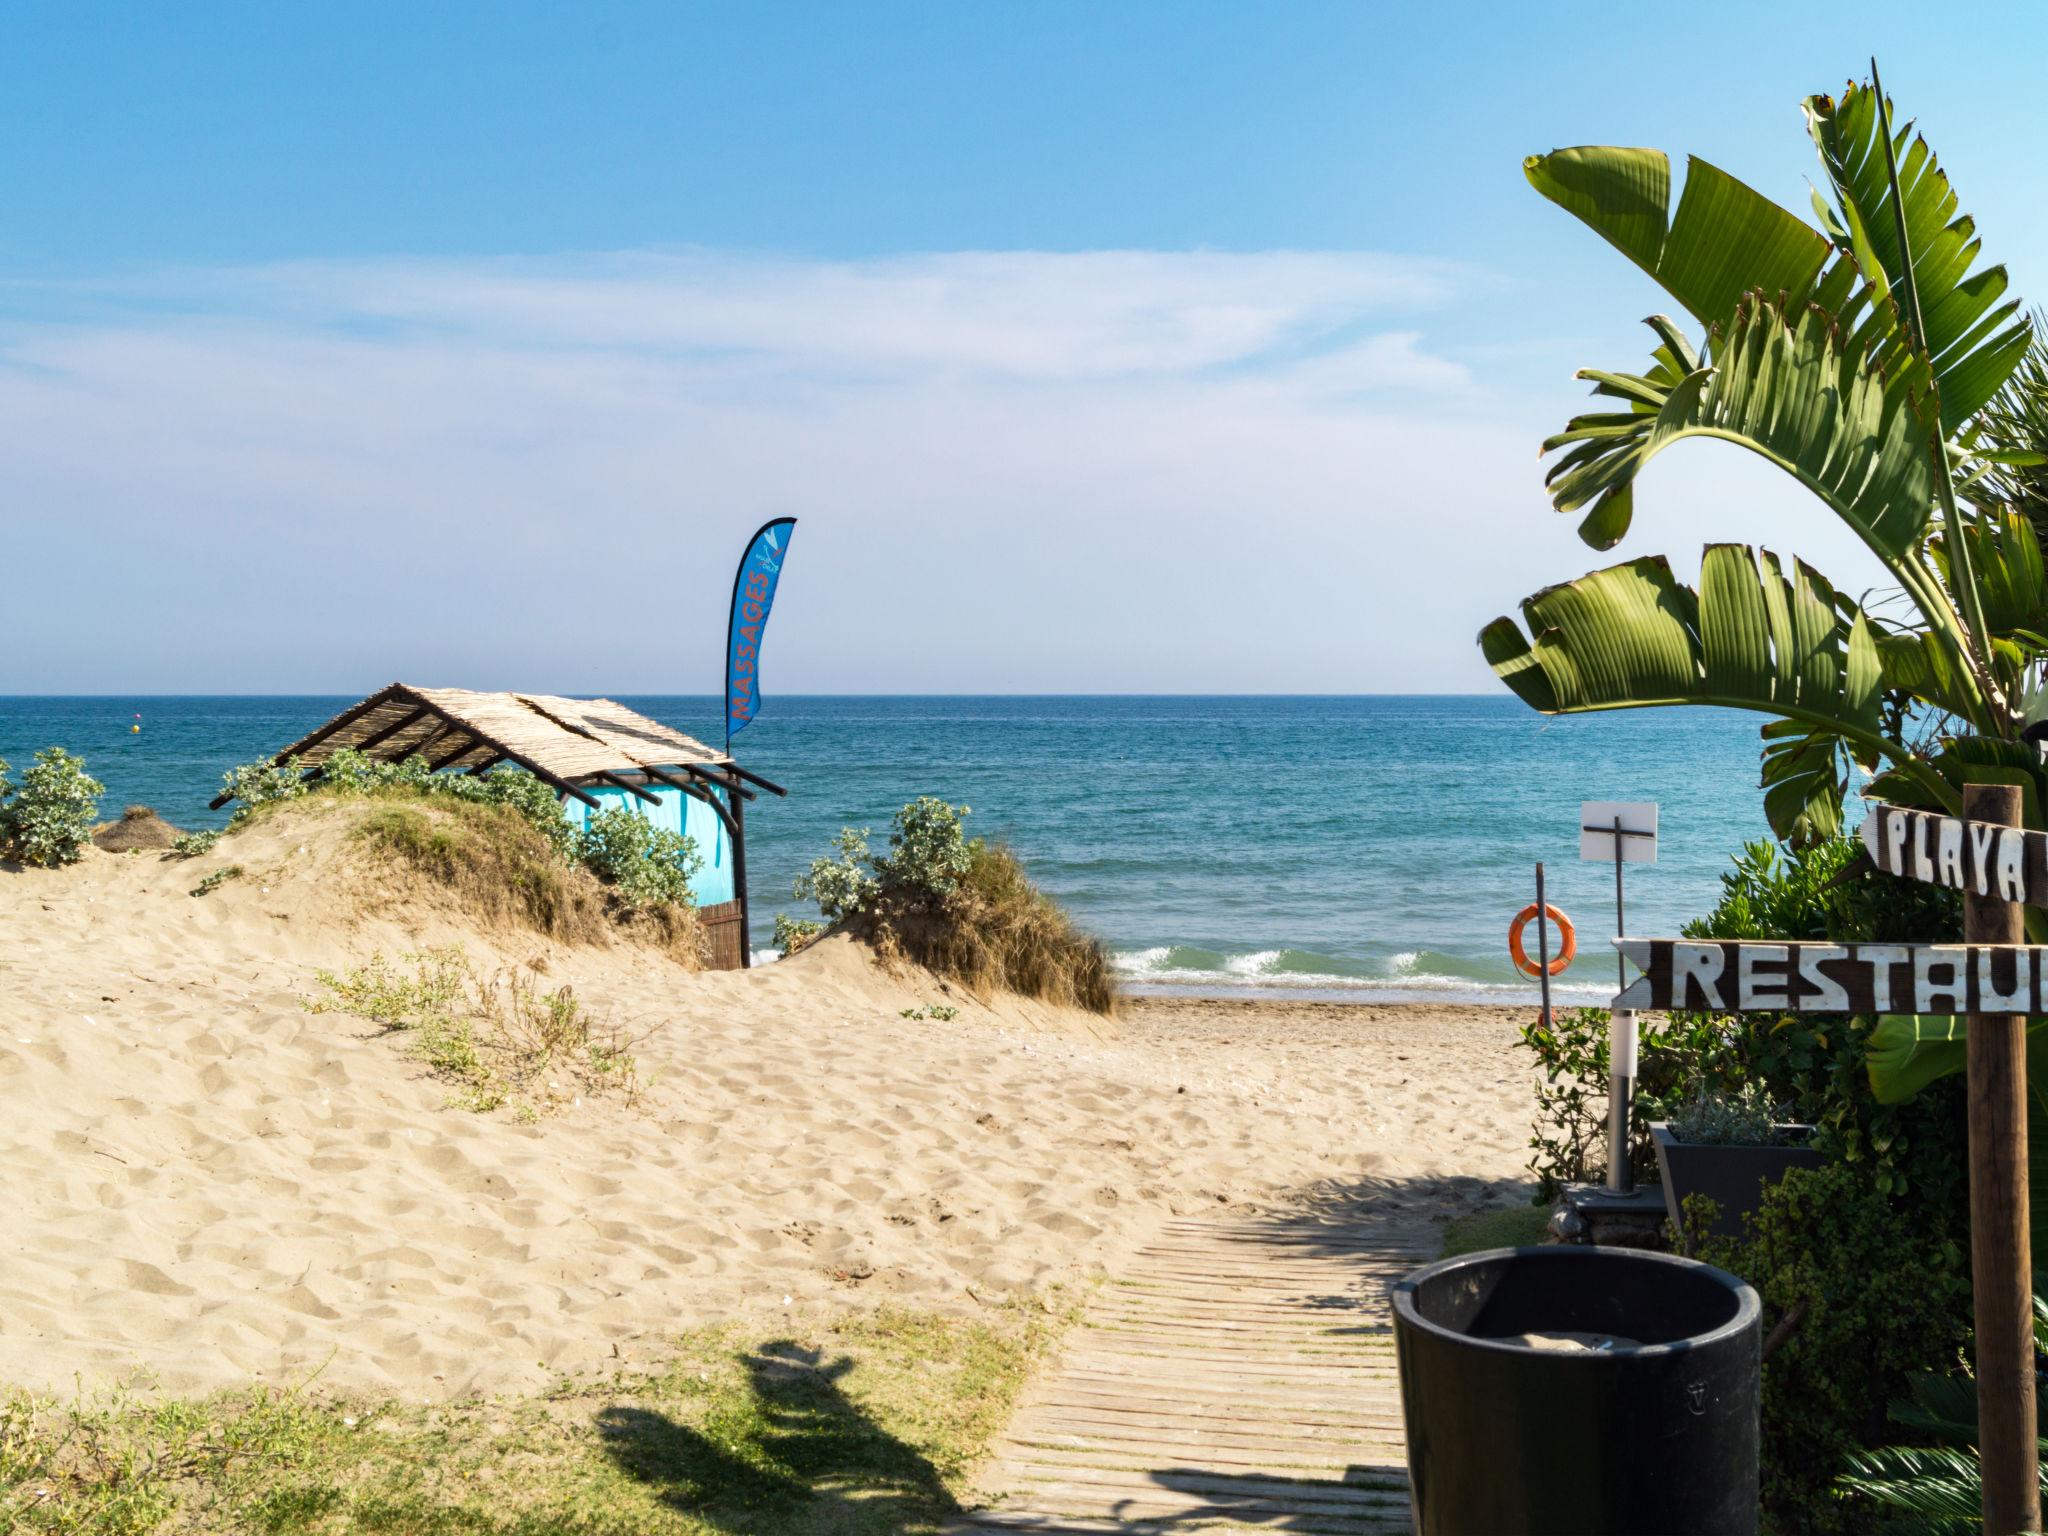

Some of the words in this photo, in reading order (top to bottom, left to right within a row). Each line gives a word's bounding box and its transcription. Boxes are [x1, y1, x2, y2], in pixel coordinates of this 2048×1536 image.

[731, 570, 769, 720] MASSAGES
[1887, 811, 2026, 903] PLAYA
[1672, 943, 2048, 1012] RESTAU
